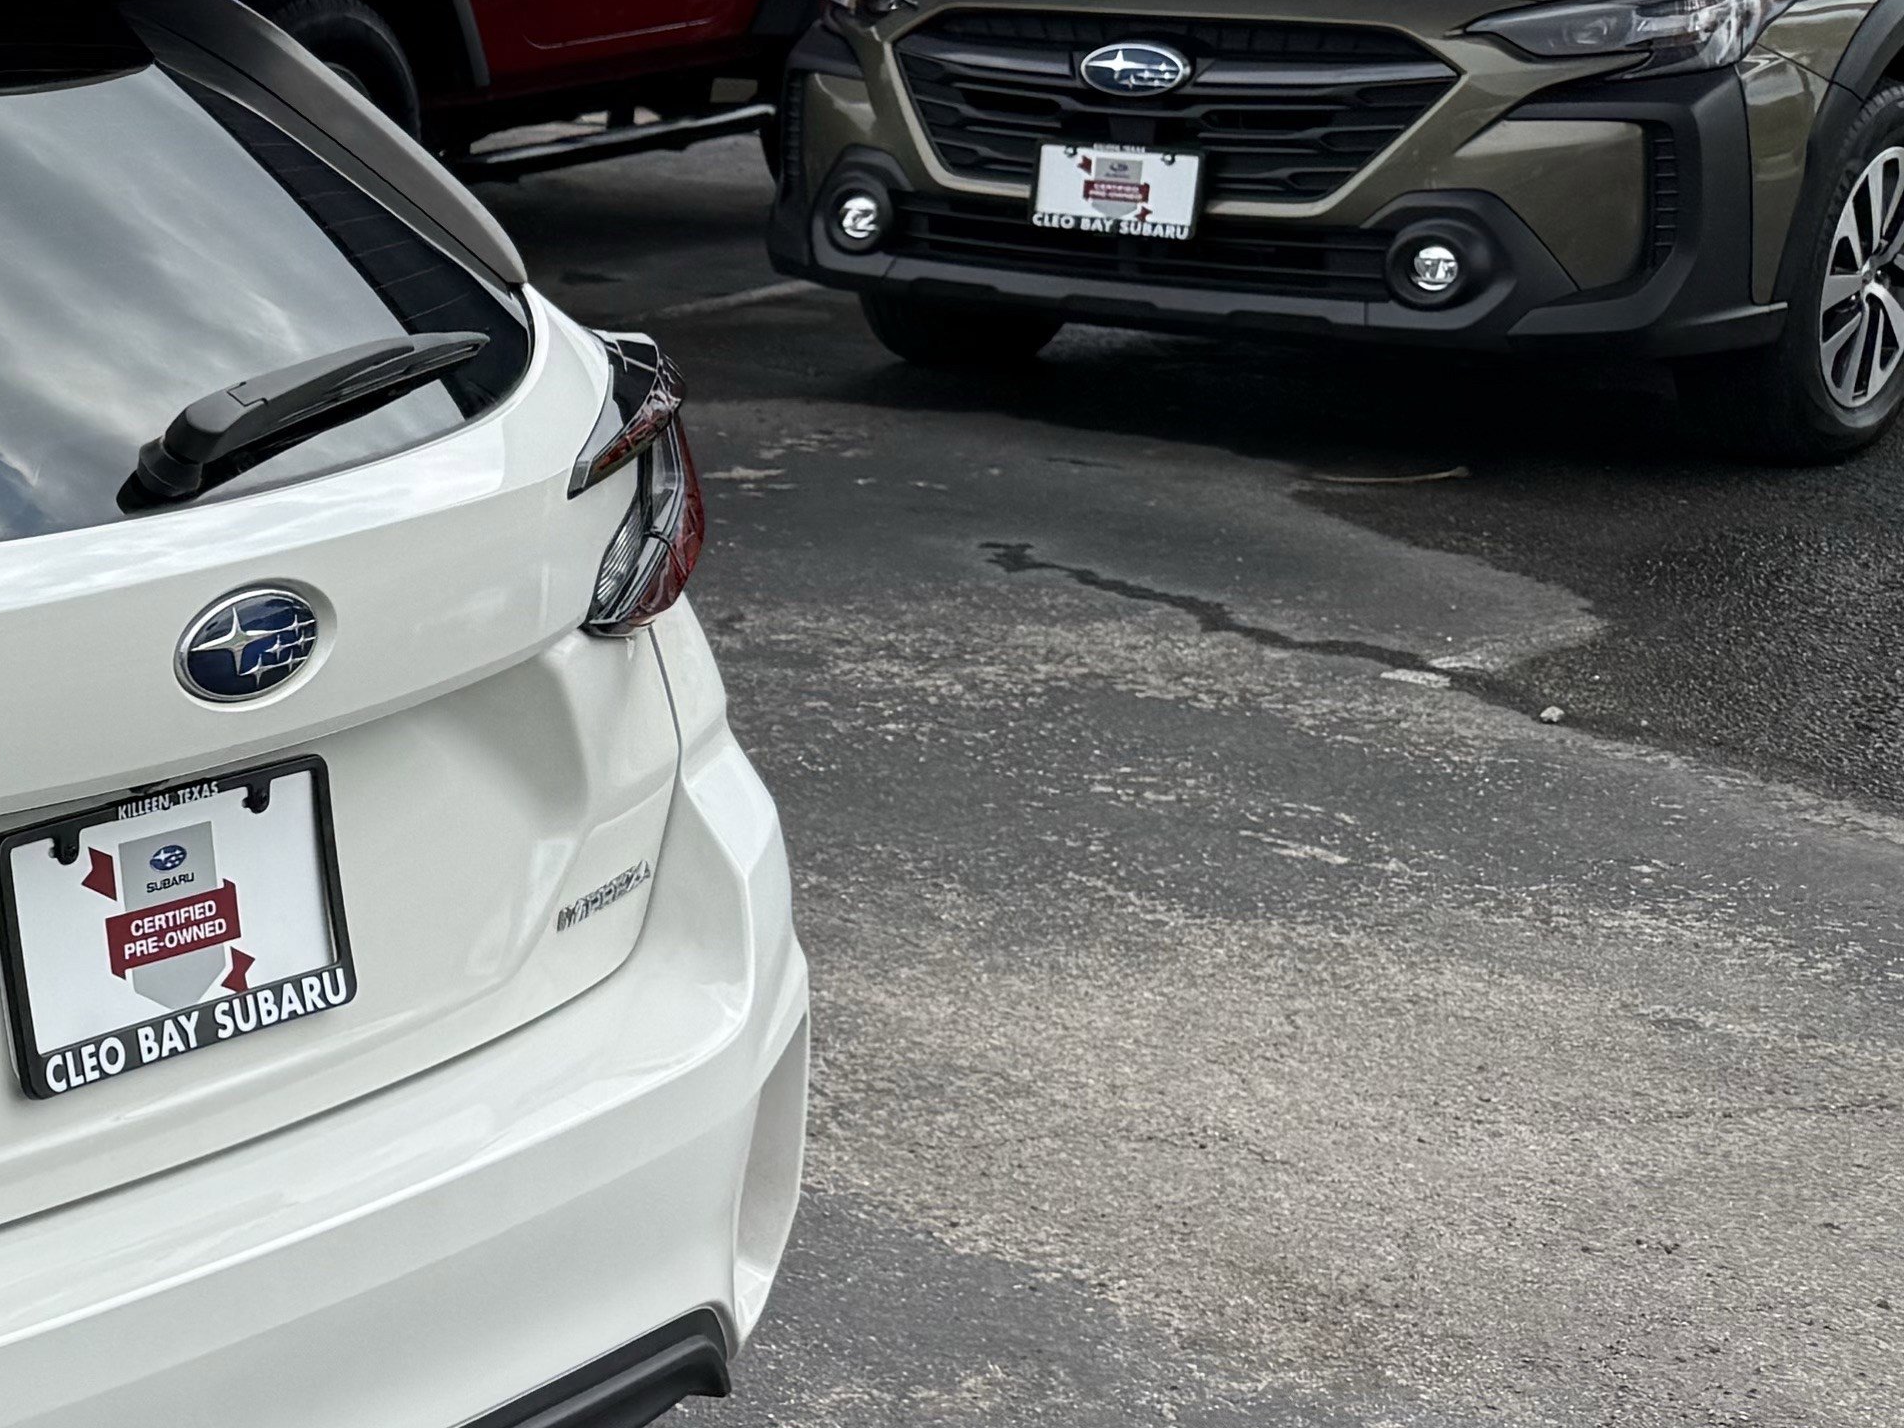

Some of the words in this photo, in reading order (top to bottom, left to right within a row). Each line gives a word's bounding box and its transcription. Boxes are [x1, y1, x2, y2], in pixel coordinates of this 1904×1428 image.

[1032, 213, 1075, 229] CLEO
[1080, 218, 1114, 233] BAY
[1119, 222, 1189, 240] SUBARU
[118, 792, 175, 821] KILLEEN,
[177, 781, 220, 806] TEXAS
[146, 872, 195, 893] SUBARU
[130, 899, 217, 937] CERTIFIED
[123, 918, 227, 960] PRE-OWNED
[45, 1036, 126, 1093] CLEO
[137, 1011, 200, 1064] BAY
[213, 967, 348, 1040] SUBARU
